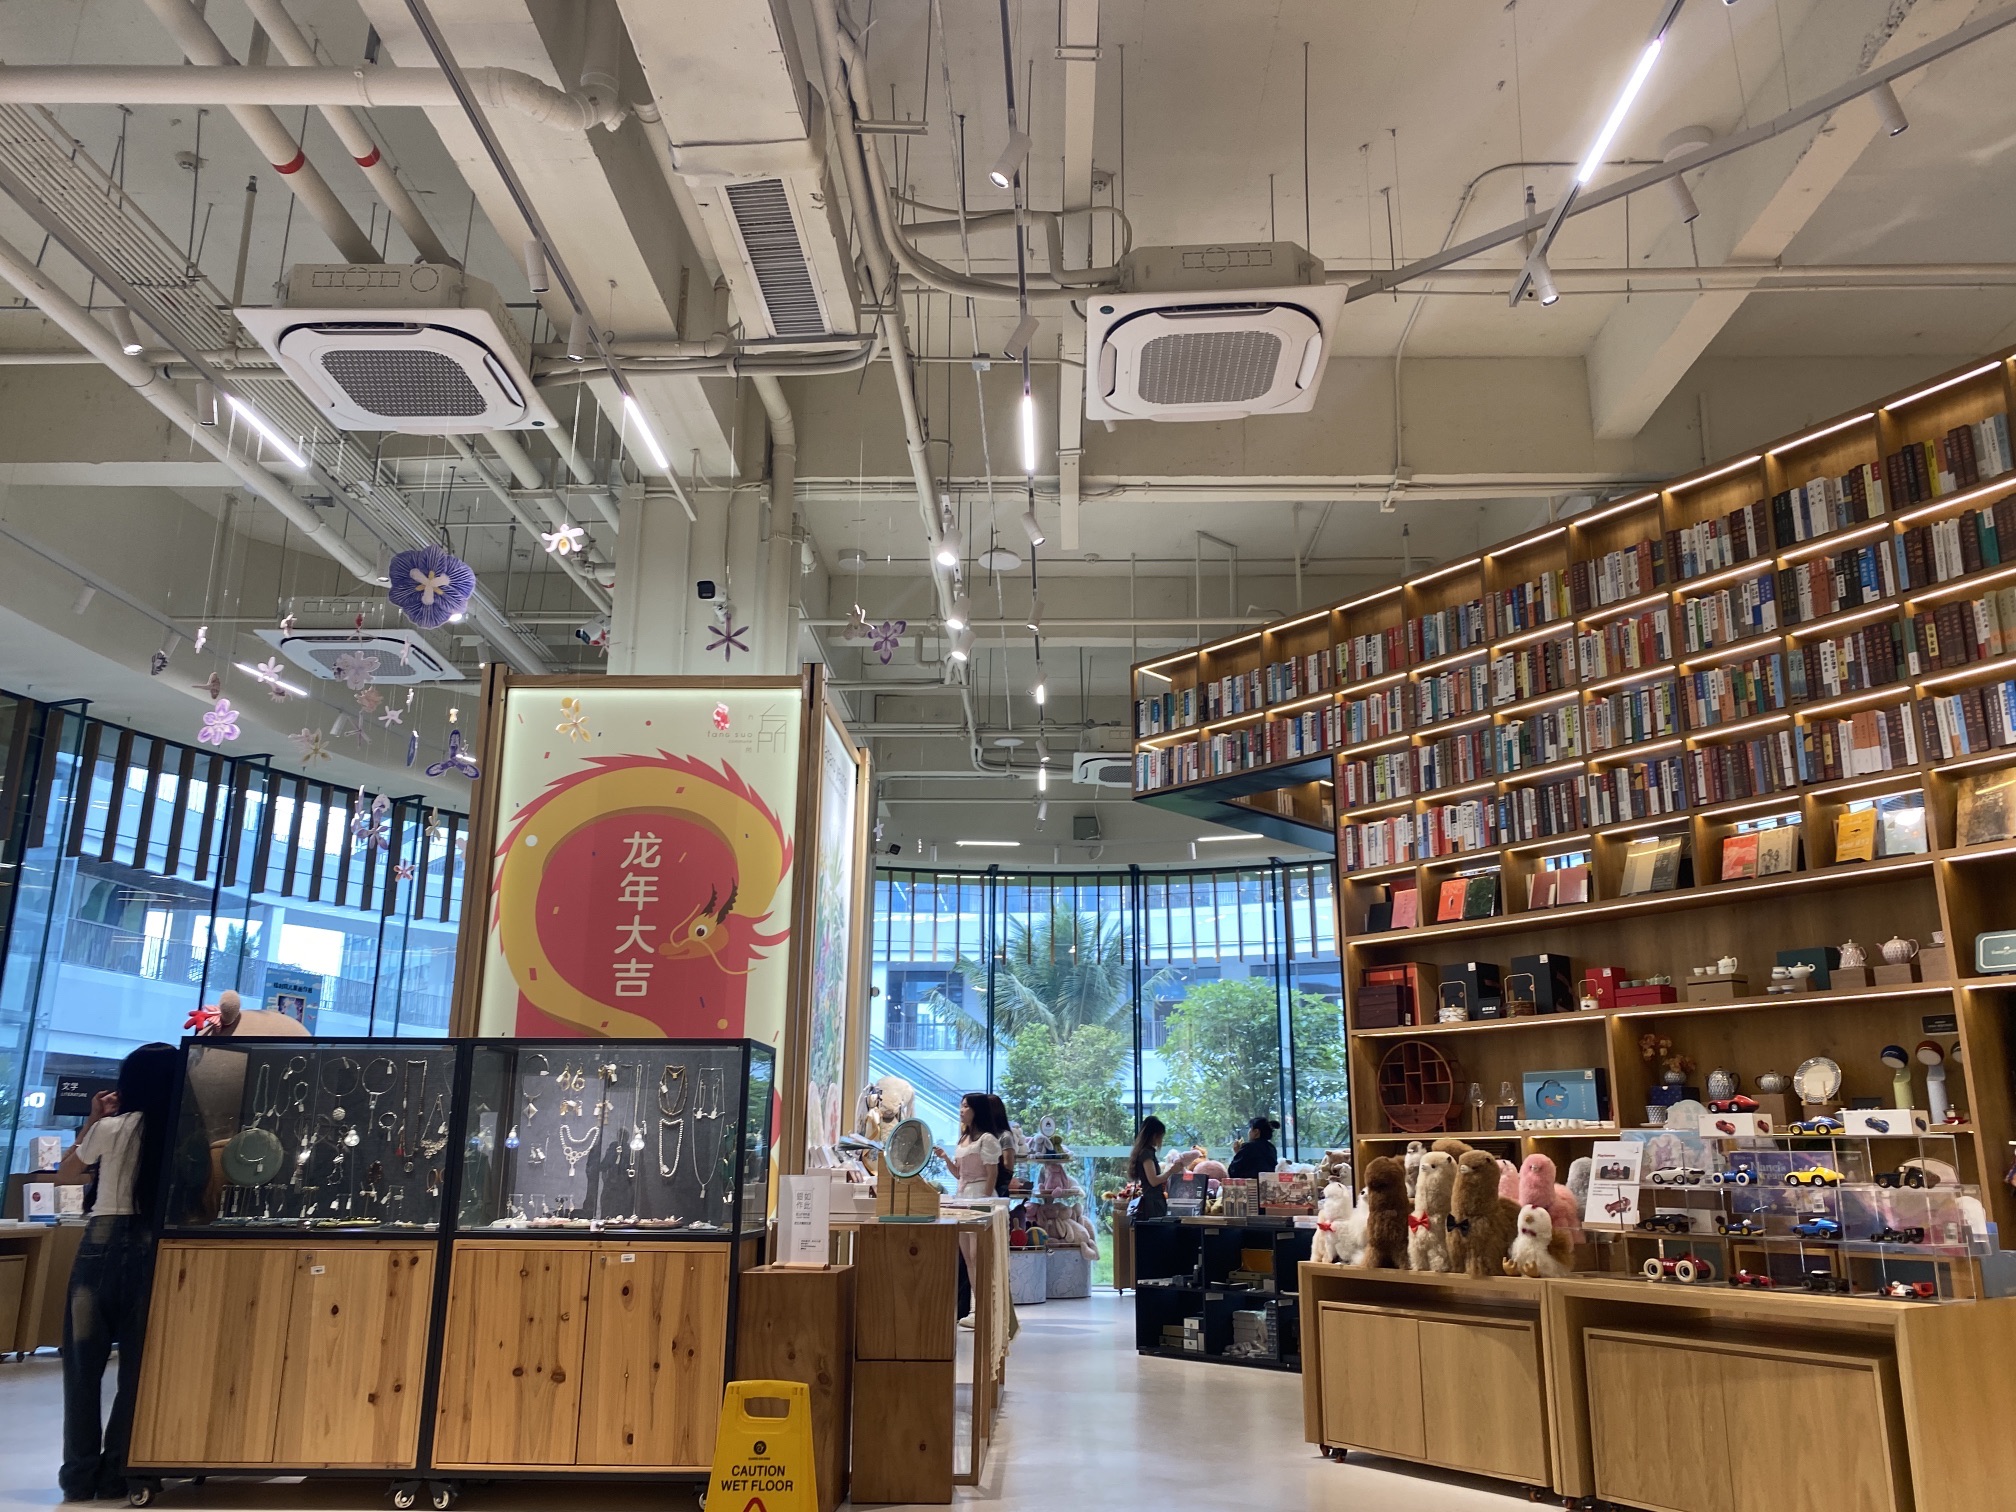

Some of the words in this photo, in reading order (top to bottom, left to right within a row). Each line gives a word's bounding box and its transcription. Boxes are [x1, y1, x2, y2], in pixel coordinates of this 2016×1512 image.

[612, 830, 664, 998] 龙年大吉
[61, 1081, 79, 1091] 文学
[731, 1465, 786, 1477] CAUTION
[721, 1480, 748, 1492] WET
[751, 1480, 794, 1492] FLOOR
